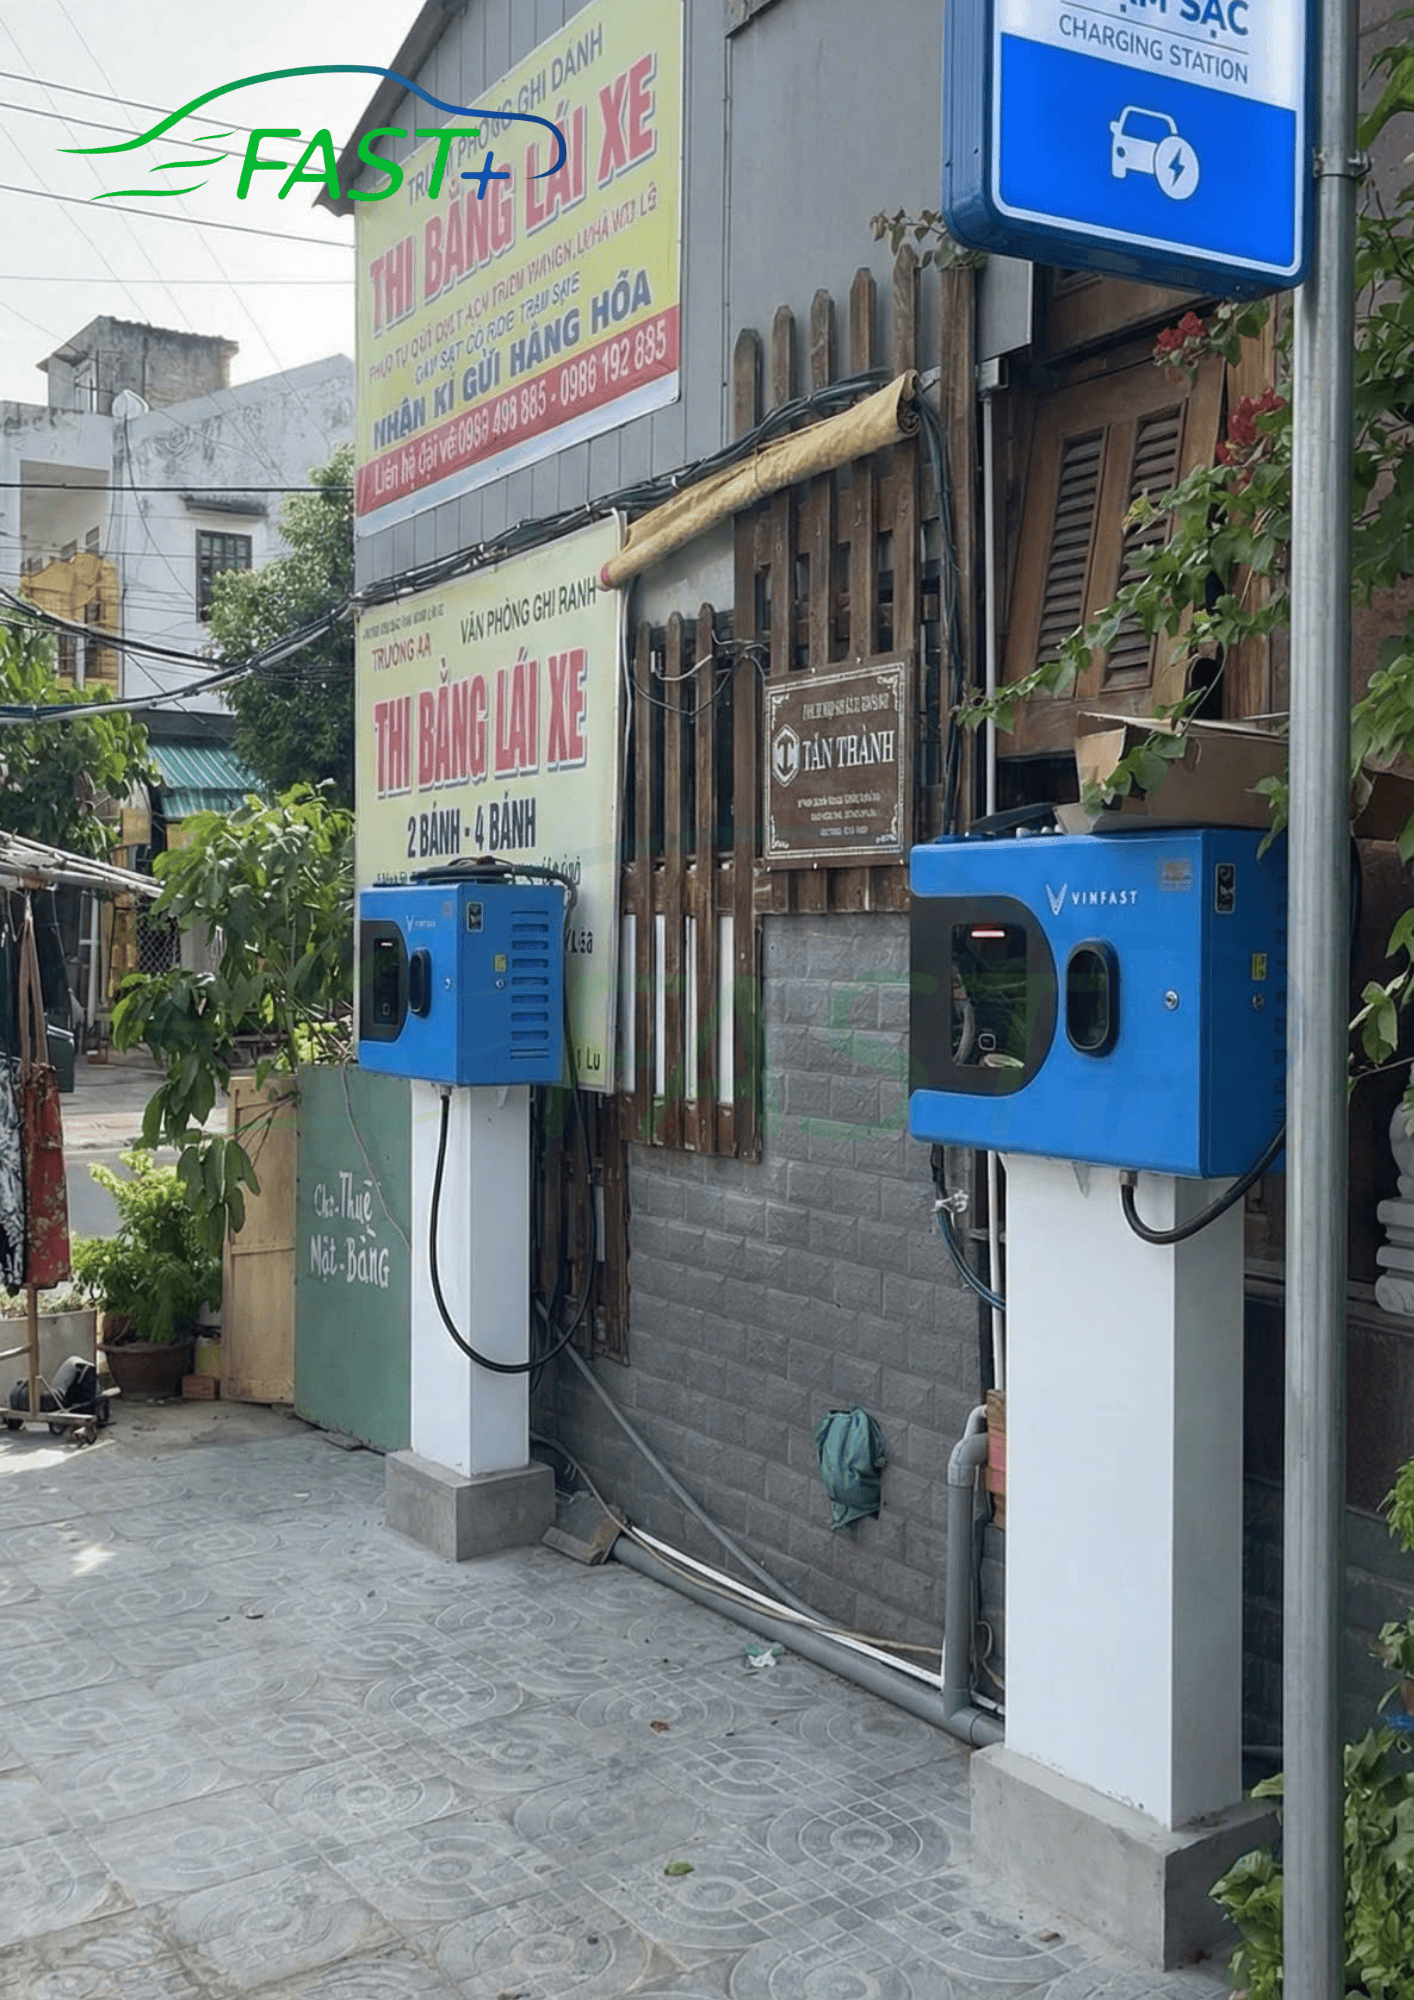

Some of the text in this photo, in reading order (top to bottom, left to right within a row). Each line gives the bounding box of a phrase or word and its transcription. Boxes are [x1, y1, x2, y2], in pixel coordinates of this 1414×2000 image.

[1059, 14, 1249, 84] CHARGING STATION
[370, 234, 415, 338] THI
[525, 98, 587, 238] LÁI
[597, 52, 657, 190] XE
[602, 337, 630, 384] 192
[533, 589, 556, 622] GHI
[374, 695, 412, 800] THI
[494, 646, 540, 781] LÁI
[546, 647, 588, 773] XE
[407, 815, 416, 859] 2
[475, 804, 485, 852] 4
[1071, 888, 1138, 905] VINFAST
